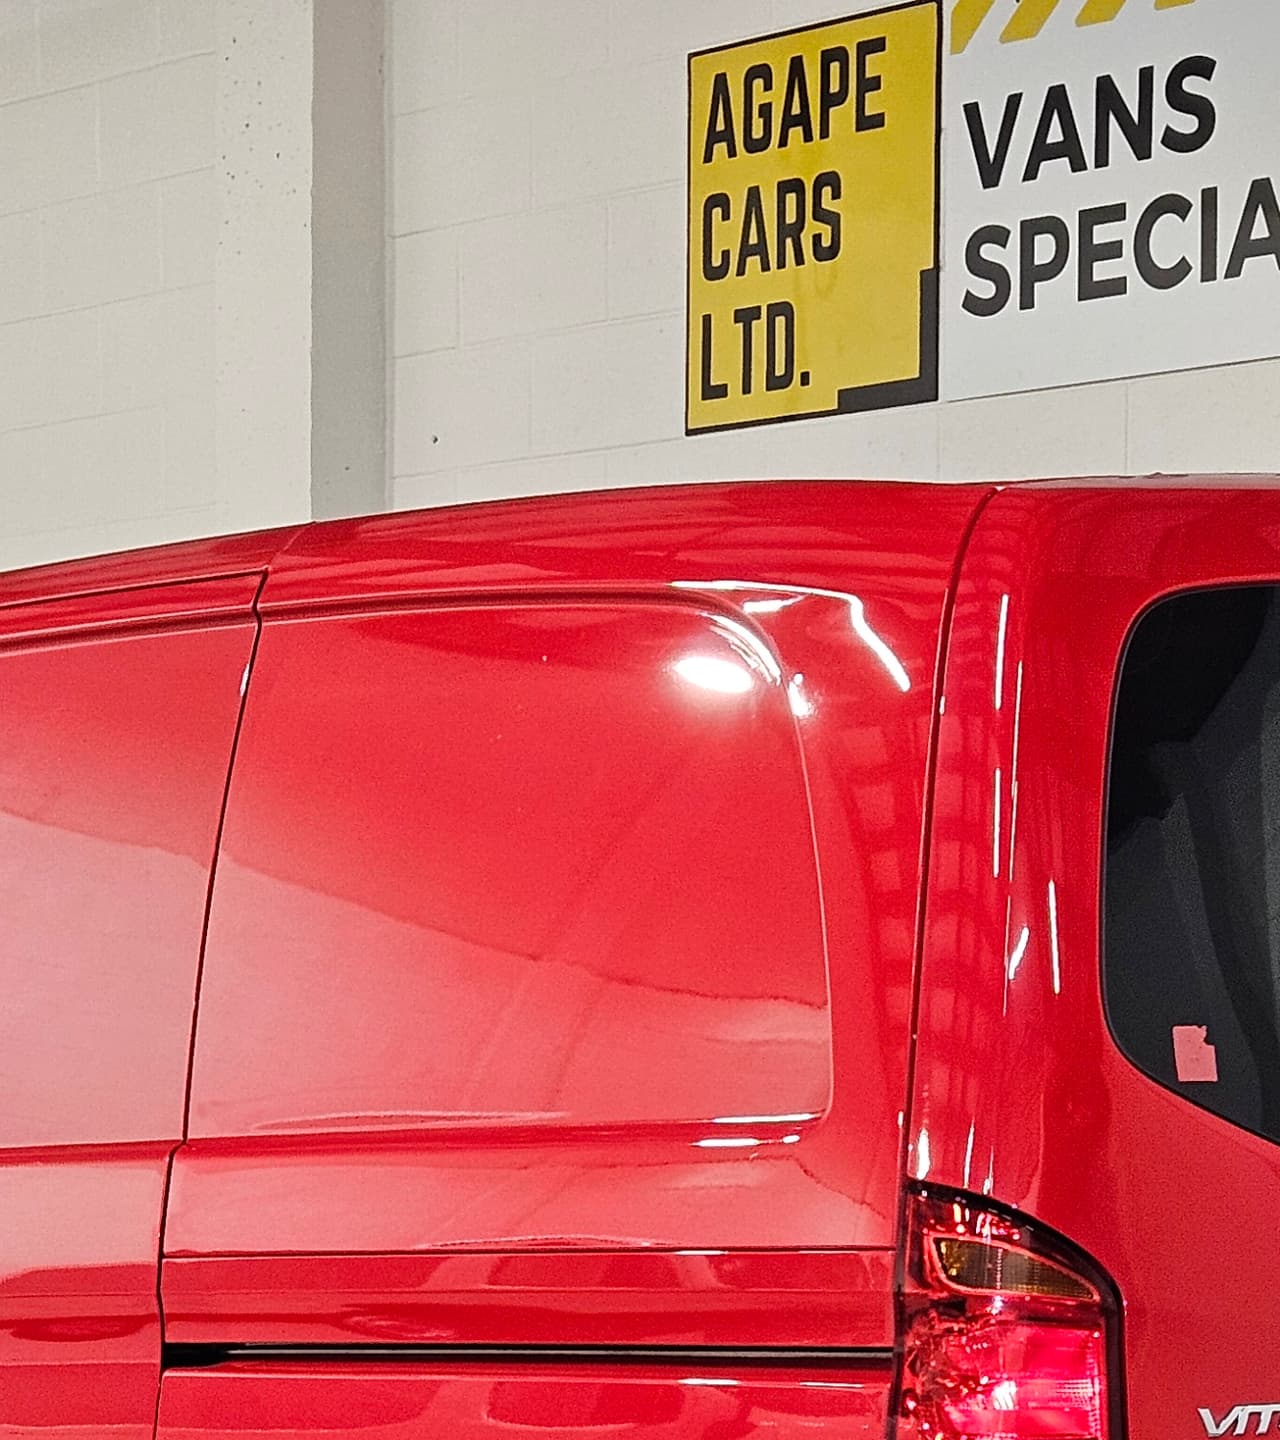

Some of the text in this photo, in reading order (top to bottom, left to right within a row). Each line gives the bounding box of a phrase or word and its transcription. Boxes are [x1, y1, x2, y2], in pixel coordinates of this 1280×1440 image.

[702, 35, 887, 165] AGAPE
[961, 55, 1217, 190] VANS
[701, 170, 842, 282] CARS
[700, 300, 811, 402] LTD.
